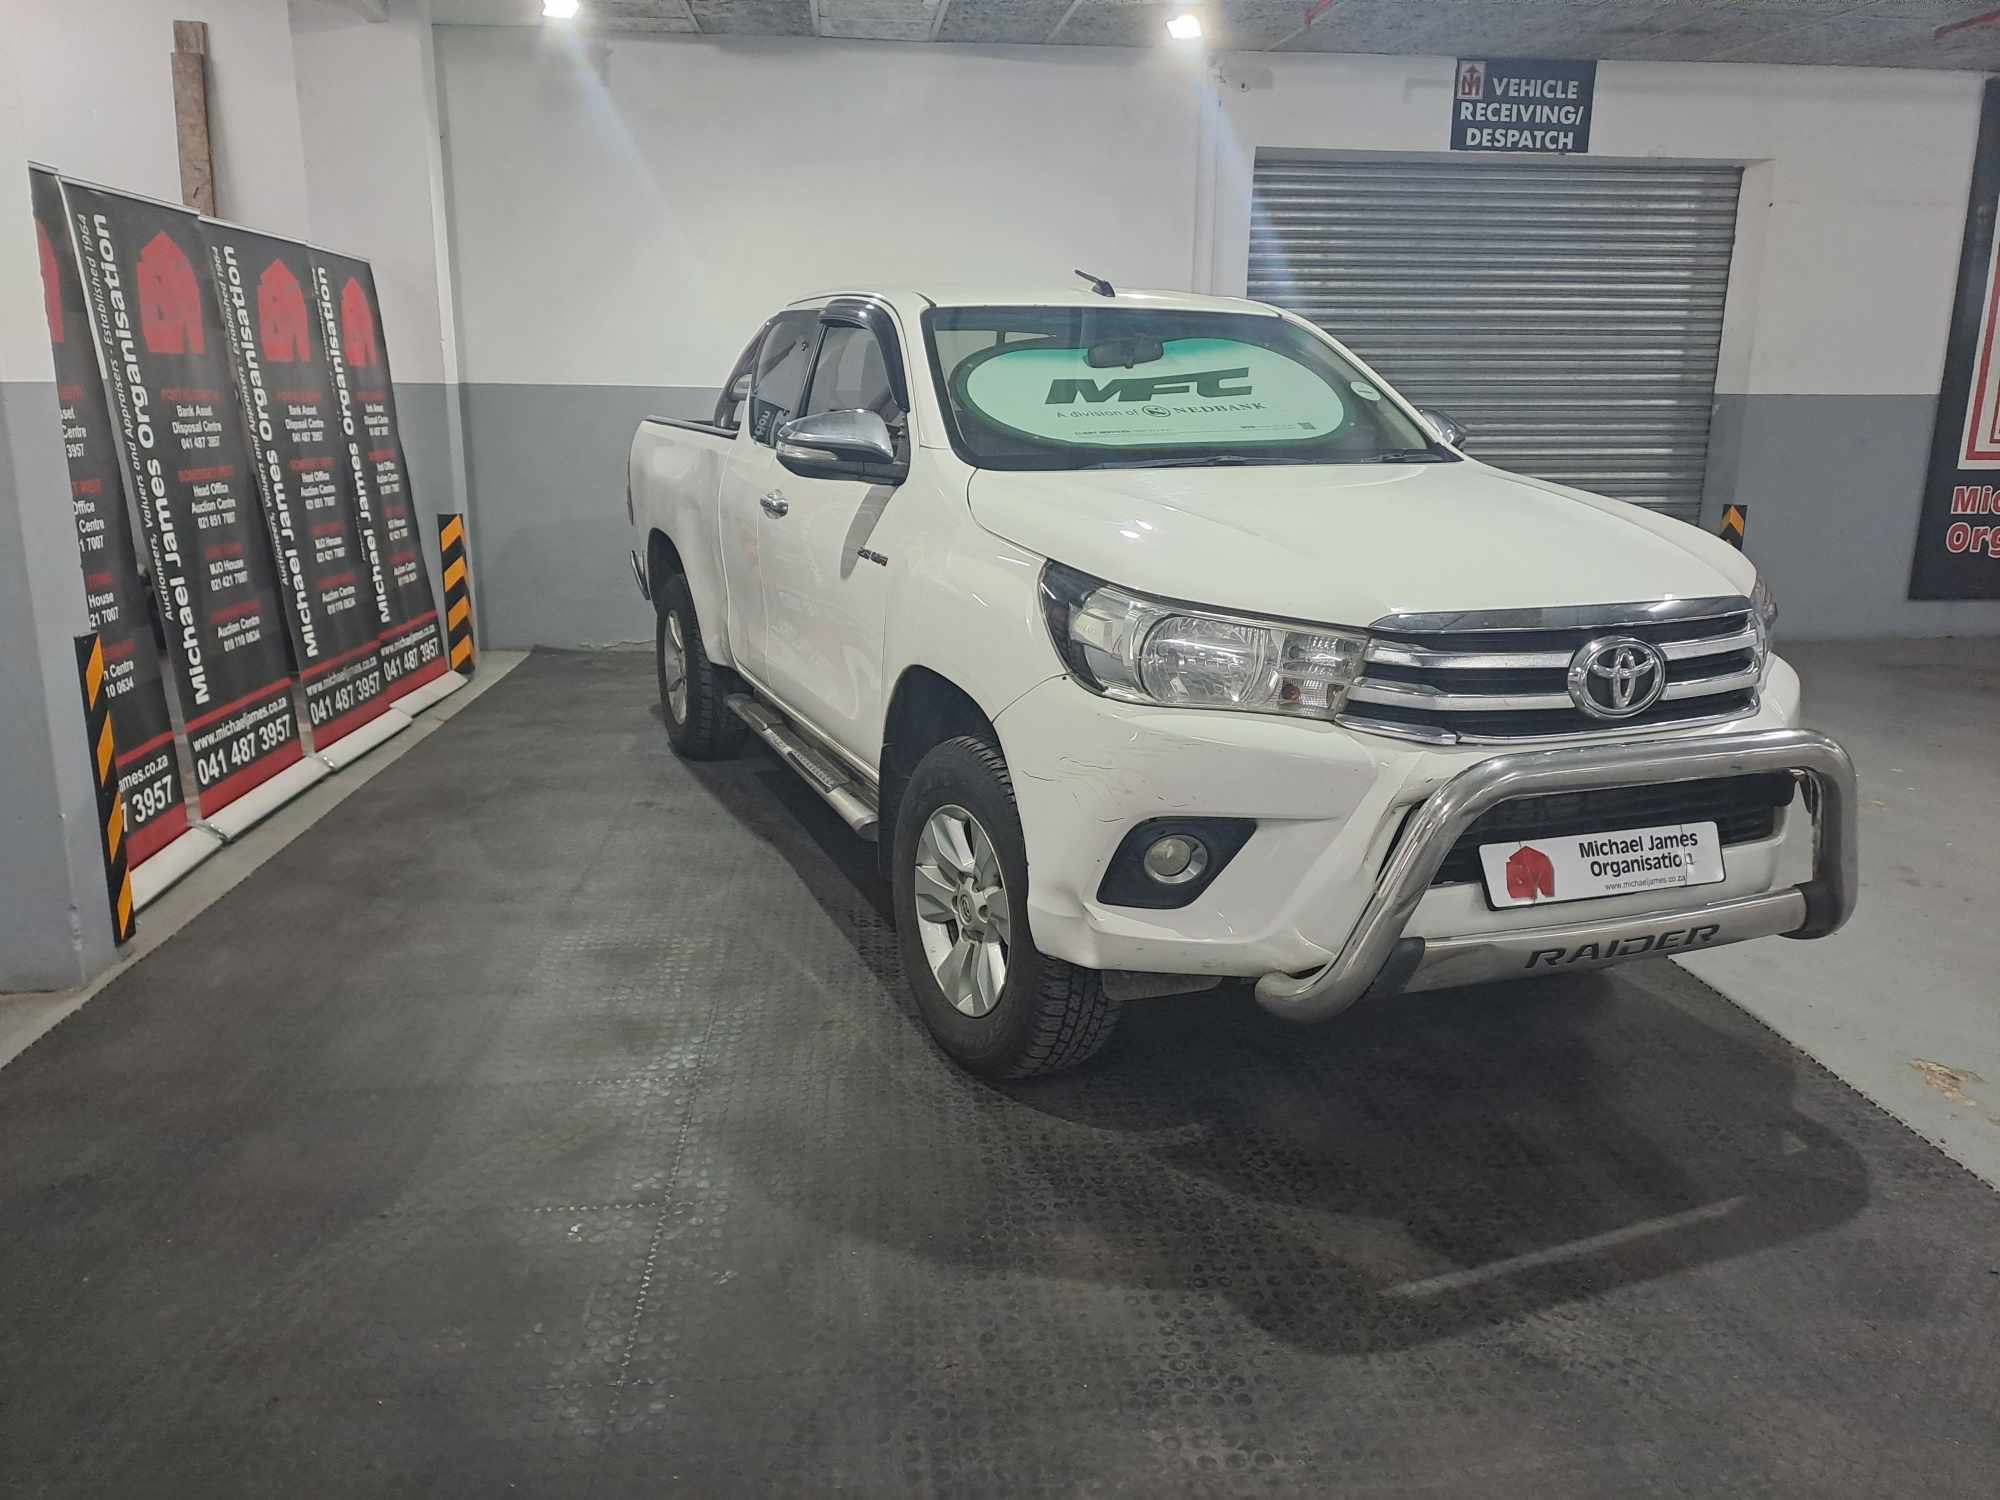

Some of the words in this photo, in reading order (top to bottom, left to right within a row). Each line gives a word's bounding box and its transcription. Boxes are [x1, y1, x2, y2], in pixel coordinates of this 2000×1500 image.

[1492, 78, 1579, 99] VEHICLE
[1460, 101, 1584, 126] RECEIVING/
[1466, 127, 1574, 150] DESPATCH
[77, 213, 92, 252] 1964
[86, 257, 114, 346] Established
[93, 214, 154, 449] Organisation
[223, 246, 272, 442] Organisation
[317, 266, 355, 436] Organisation
[110, 359, 135, 440] Appraisers
[1044, 367, 1252, 404] MFC
[172, 421, 202, 435] Disposal
[1056, 410, 1068, 419] A
[1070, 409, 1121, 418] division
[1122, 408, 1138, 416] of
[1174, 402, 1266, 416] NEDBANK
[126, 441, 141, 470] and
[266, 450, 295, 542] James
[348, 442, 372, 522] James
[79, 518, 104, 534] Centre
[146, 459, 182, 568] James
[192, 501, 216, 514] Auction
[363, 528, 391, 624] Michael
[88, 592, 114, 608] House
[284, 548, 319, 658] Michael
[169, 576, 210, 705] Michael
[383, 656, 403, 681] 041
[404, 648, 419, 672] 487
[420, 637, 439, 662] 3957
[110, 659, 134, 678] Centre
[310, 696, 333, 725] 041
[335, 685, 354, 712] 487
[356, 671, 380, 700] 3957
[192, 697, 287, 752] www.michaeljames.co.za
[198, 748, 228, 785] 041
[232, 732, 256, 766] 487
[259, 714, 290, 750] 3957
[132, 774, 172, 823] 3957
[1578, 836, 1644, 858] Michael
[1648, 832, 1698, 850] James
[1524, 924, 1720, 968] RAIDER
